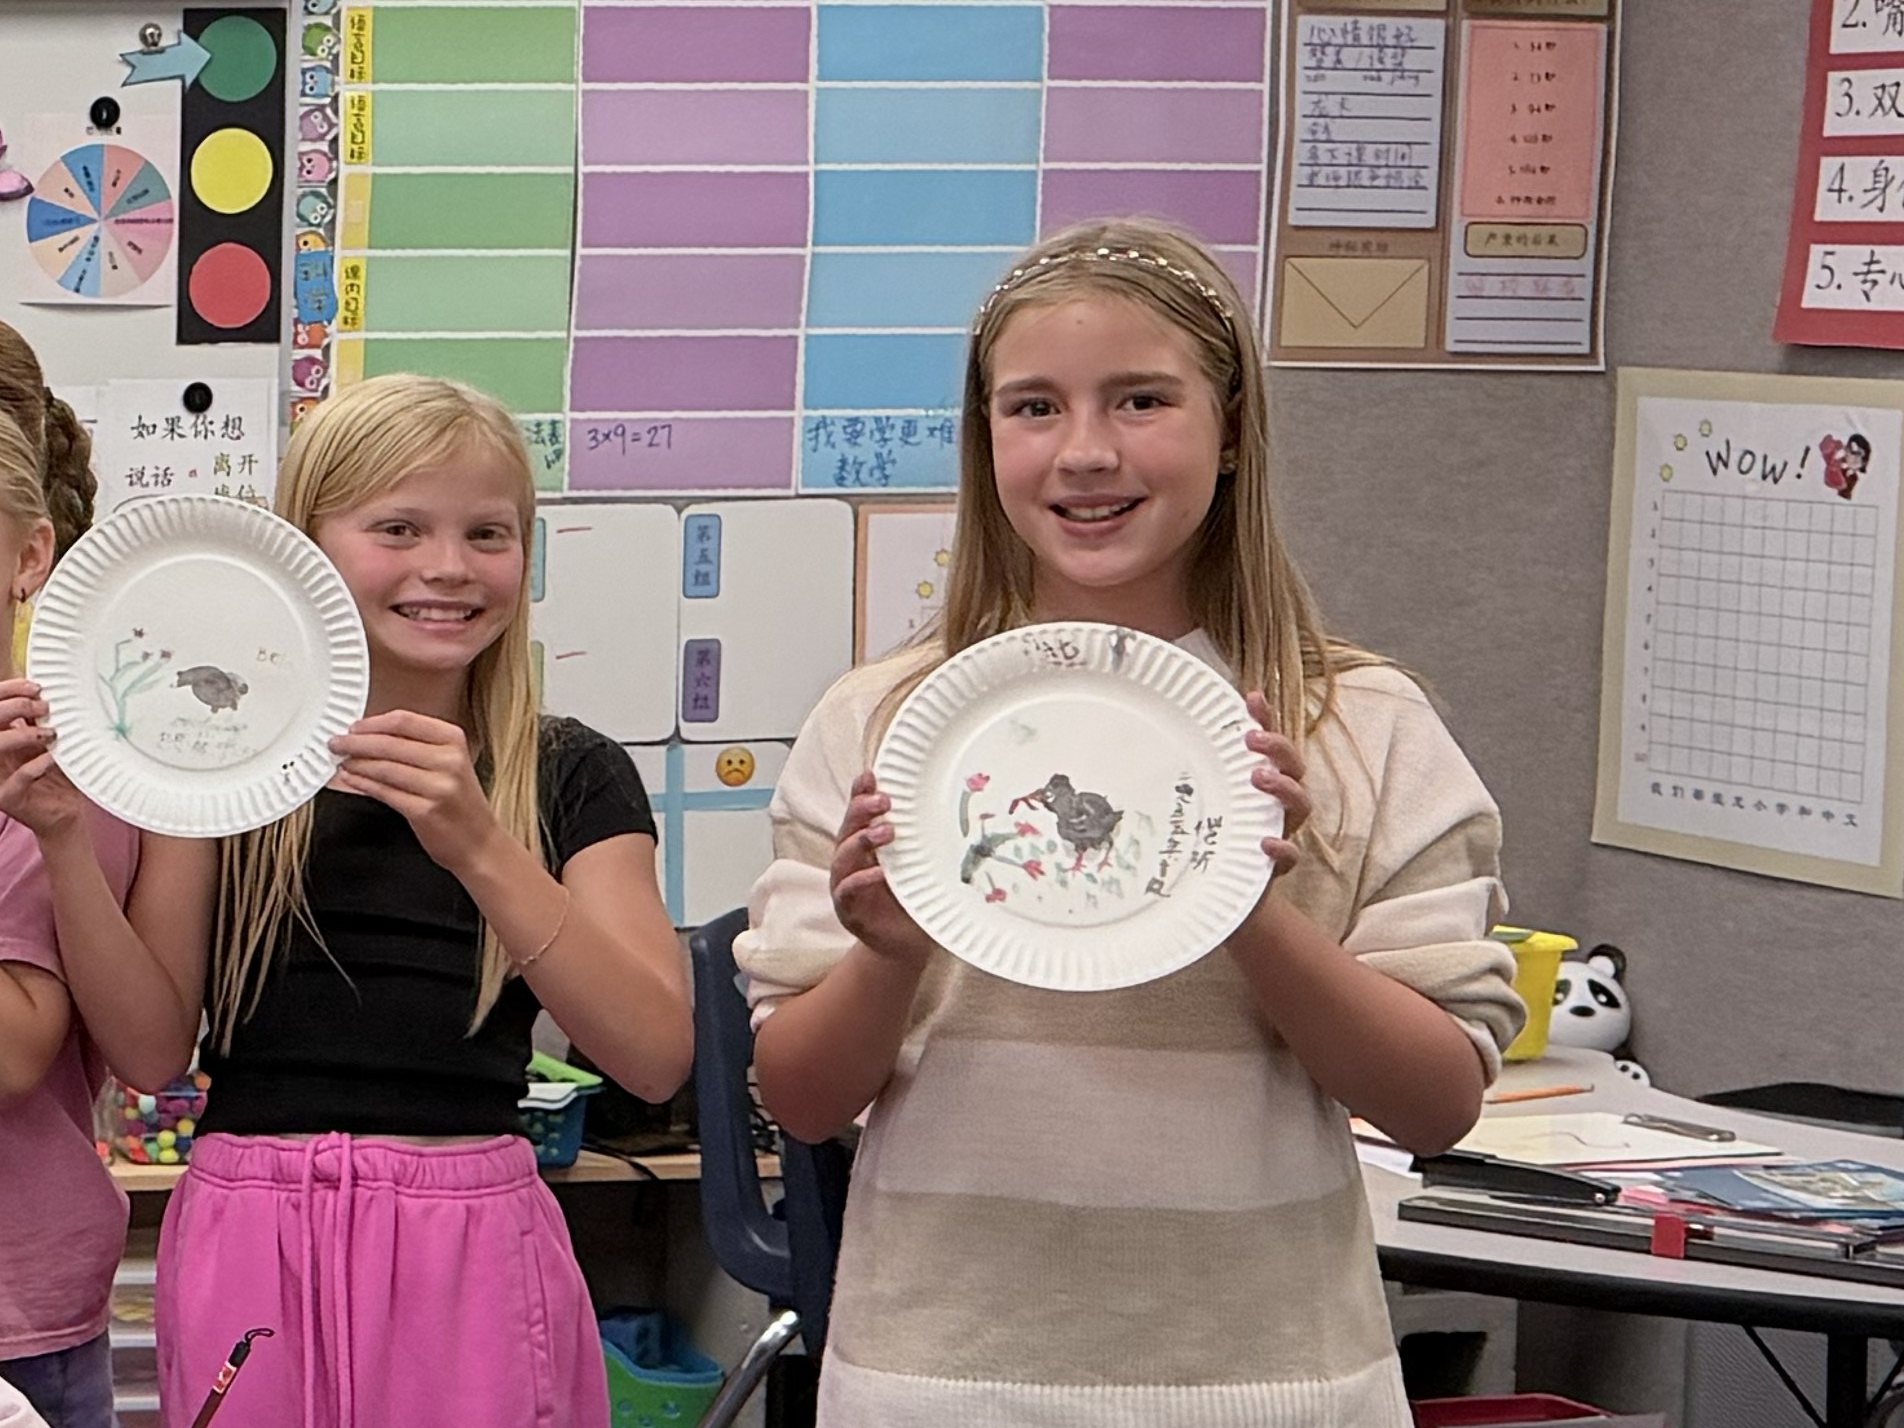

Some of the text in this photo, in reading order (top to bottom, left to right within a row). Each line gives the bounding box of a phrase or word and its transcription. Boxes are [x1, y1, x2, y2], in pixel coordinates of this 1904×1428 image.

[130, 413, 246, 441] 如果你想
[124, 465, 176, 488] 说话
[212, 451, 259, 477] 离开
